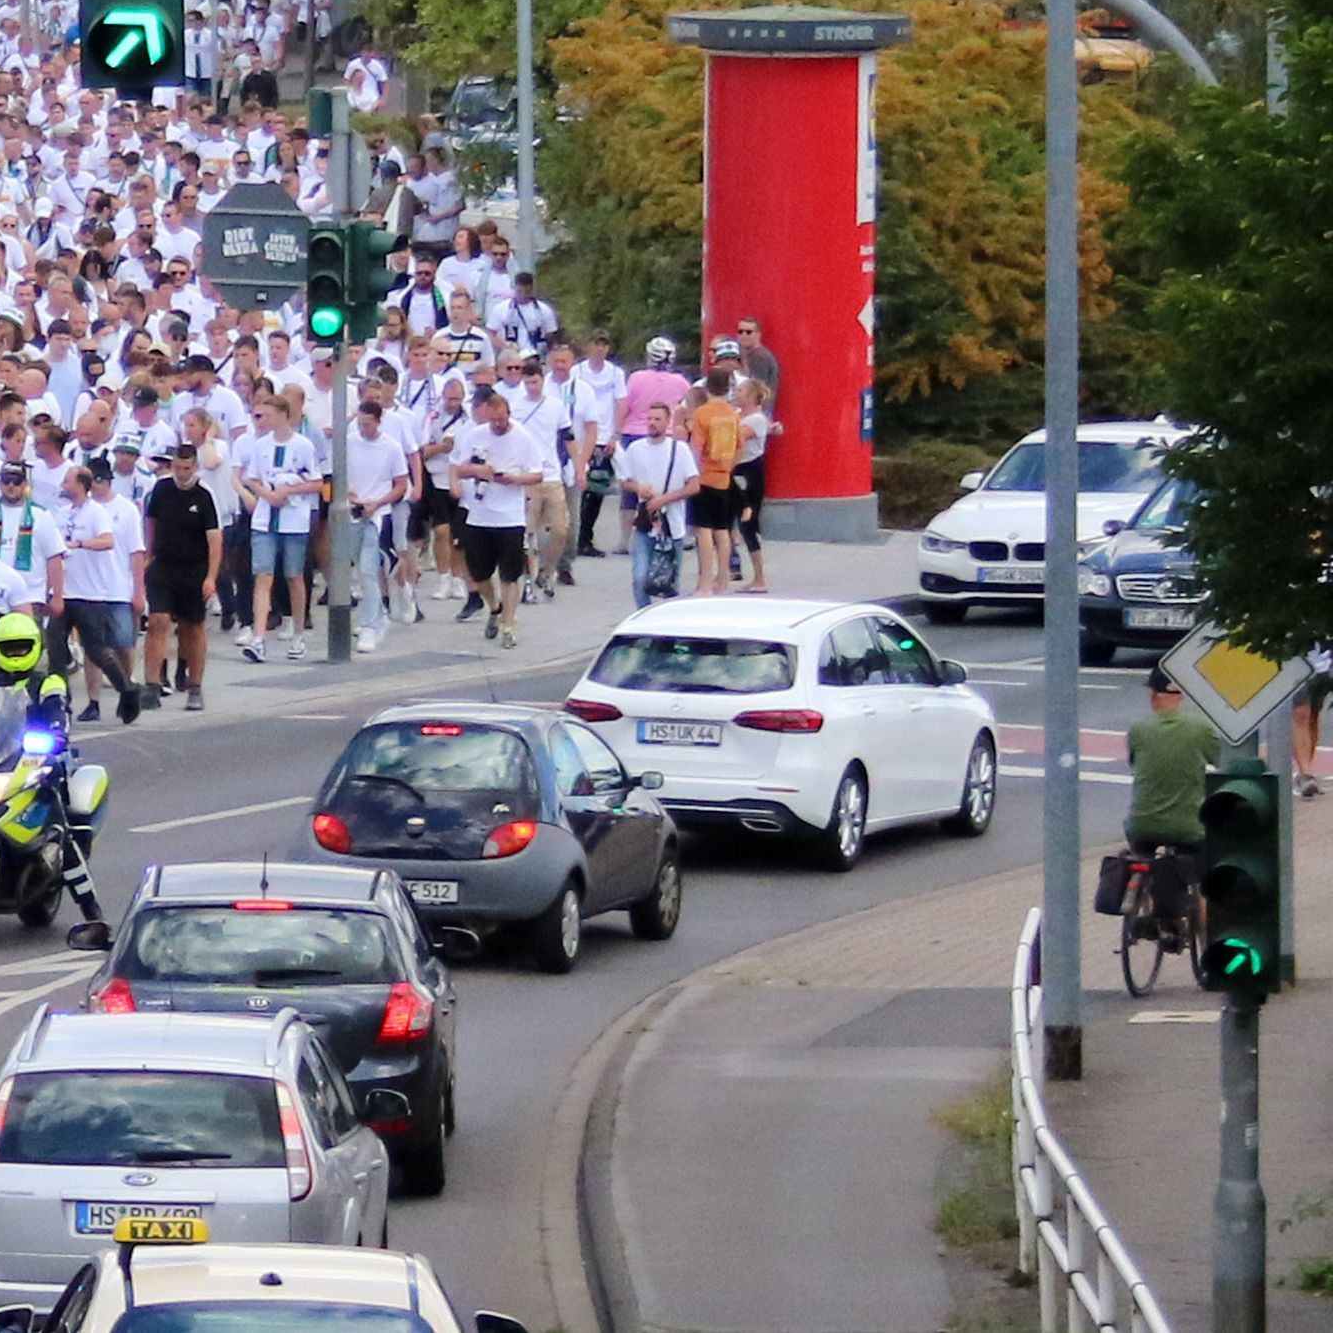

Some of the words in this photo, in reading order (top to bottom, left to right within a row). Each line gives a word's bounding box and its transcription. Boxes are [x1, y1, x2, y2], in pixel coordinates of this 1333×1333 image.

[422, 883, 452, 899] 512
[89, 1207, 121, 1227] HS
[132, 1221, 193, 1239] TAXI
